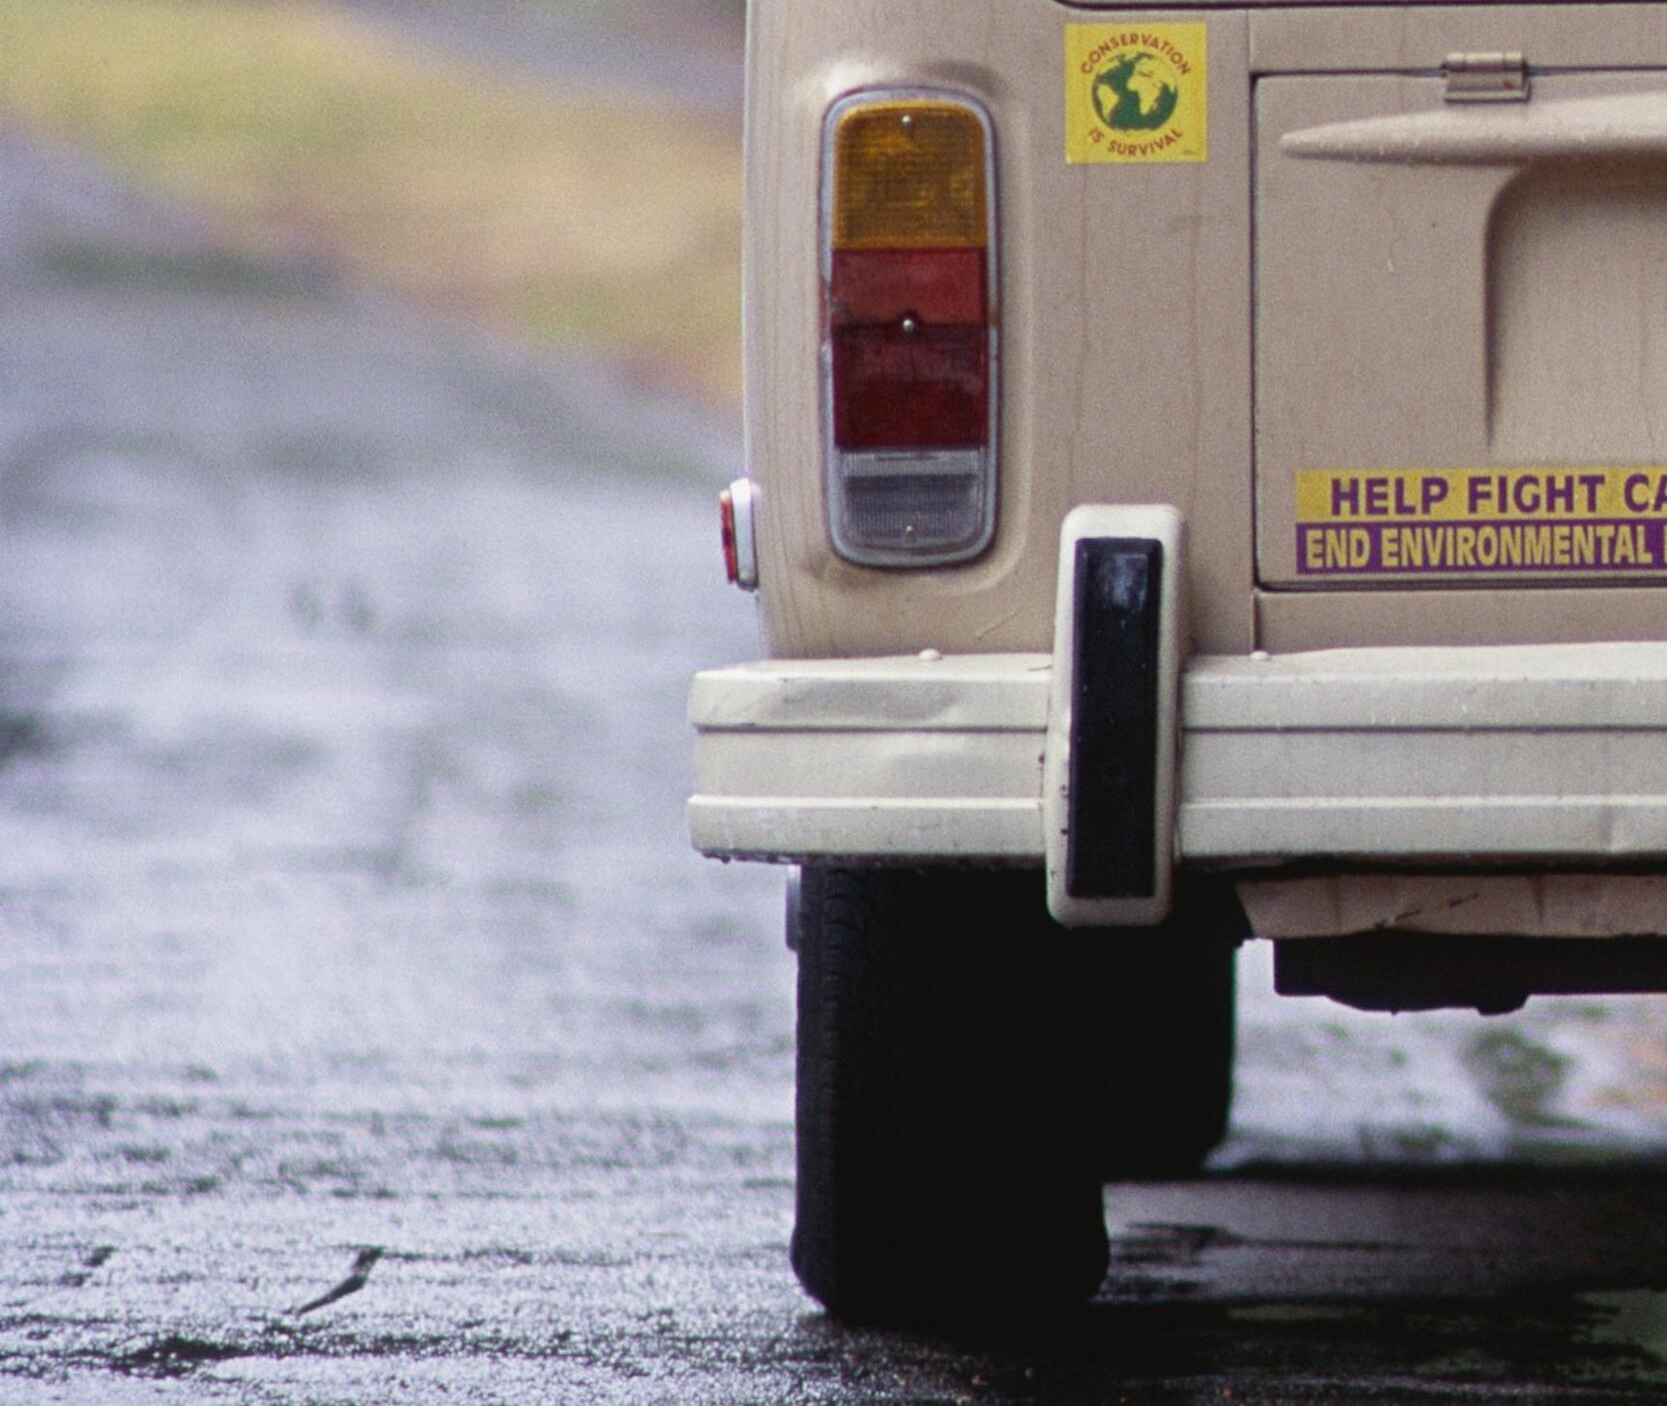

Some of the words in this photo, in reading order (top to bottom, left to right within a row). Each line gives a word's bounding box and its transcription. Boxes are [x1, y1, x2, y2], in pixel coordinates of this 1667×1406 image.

[1081, 33, 1191, 74] CONSERVATION
[1107, 128, 1183, 156] SURVIVAL
[1330, 476, 1450, 517] HELP
[1467, 474, 1606, 515] FIGHT
[1306, 526, 1370, 569] END
[1381, 523, 1653, 567] ENVIRONMENTAL
